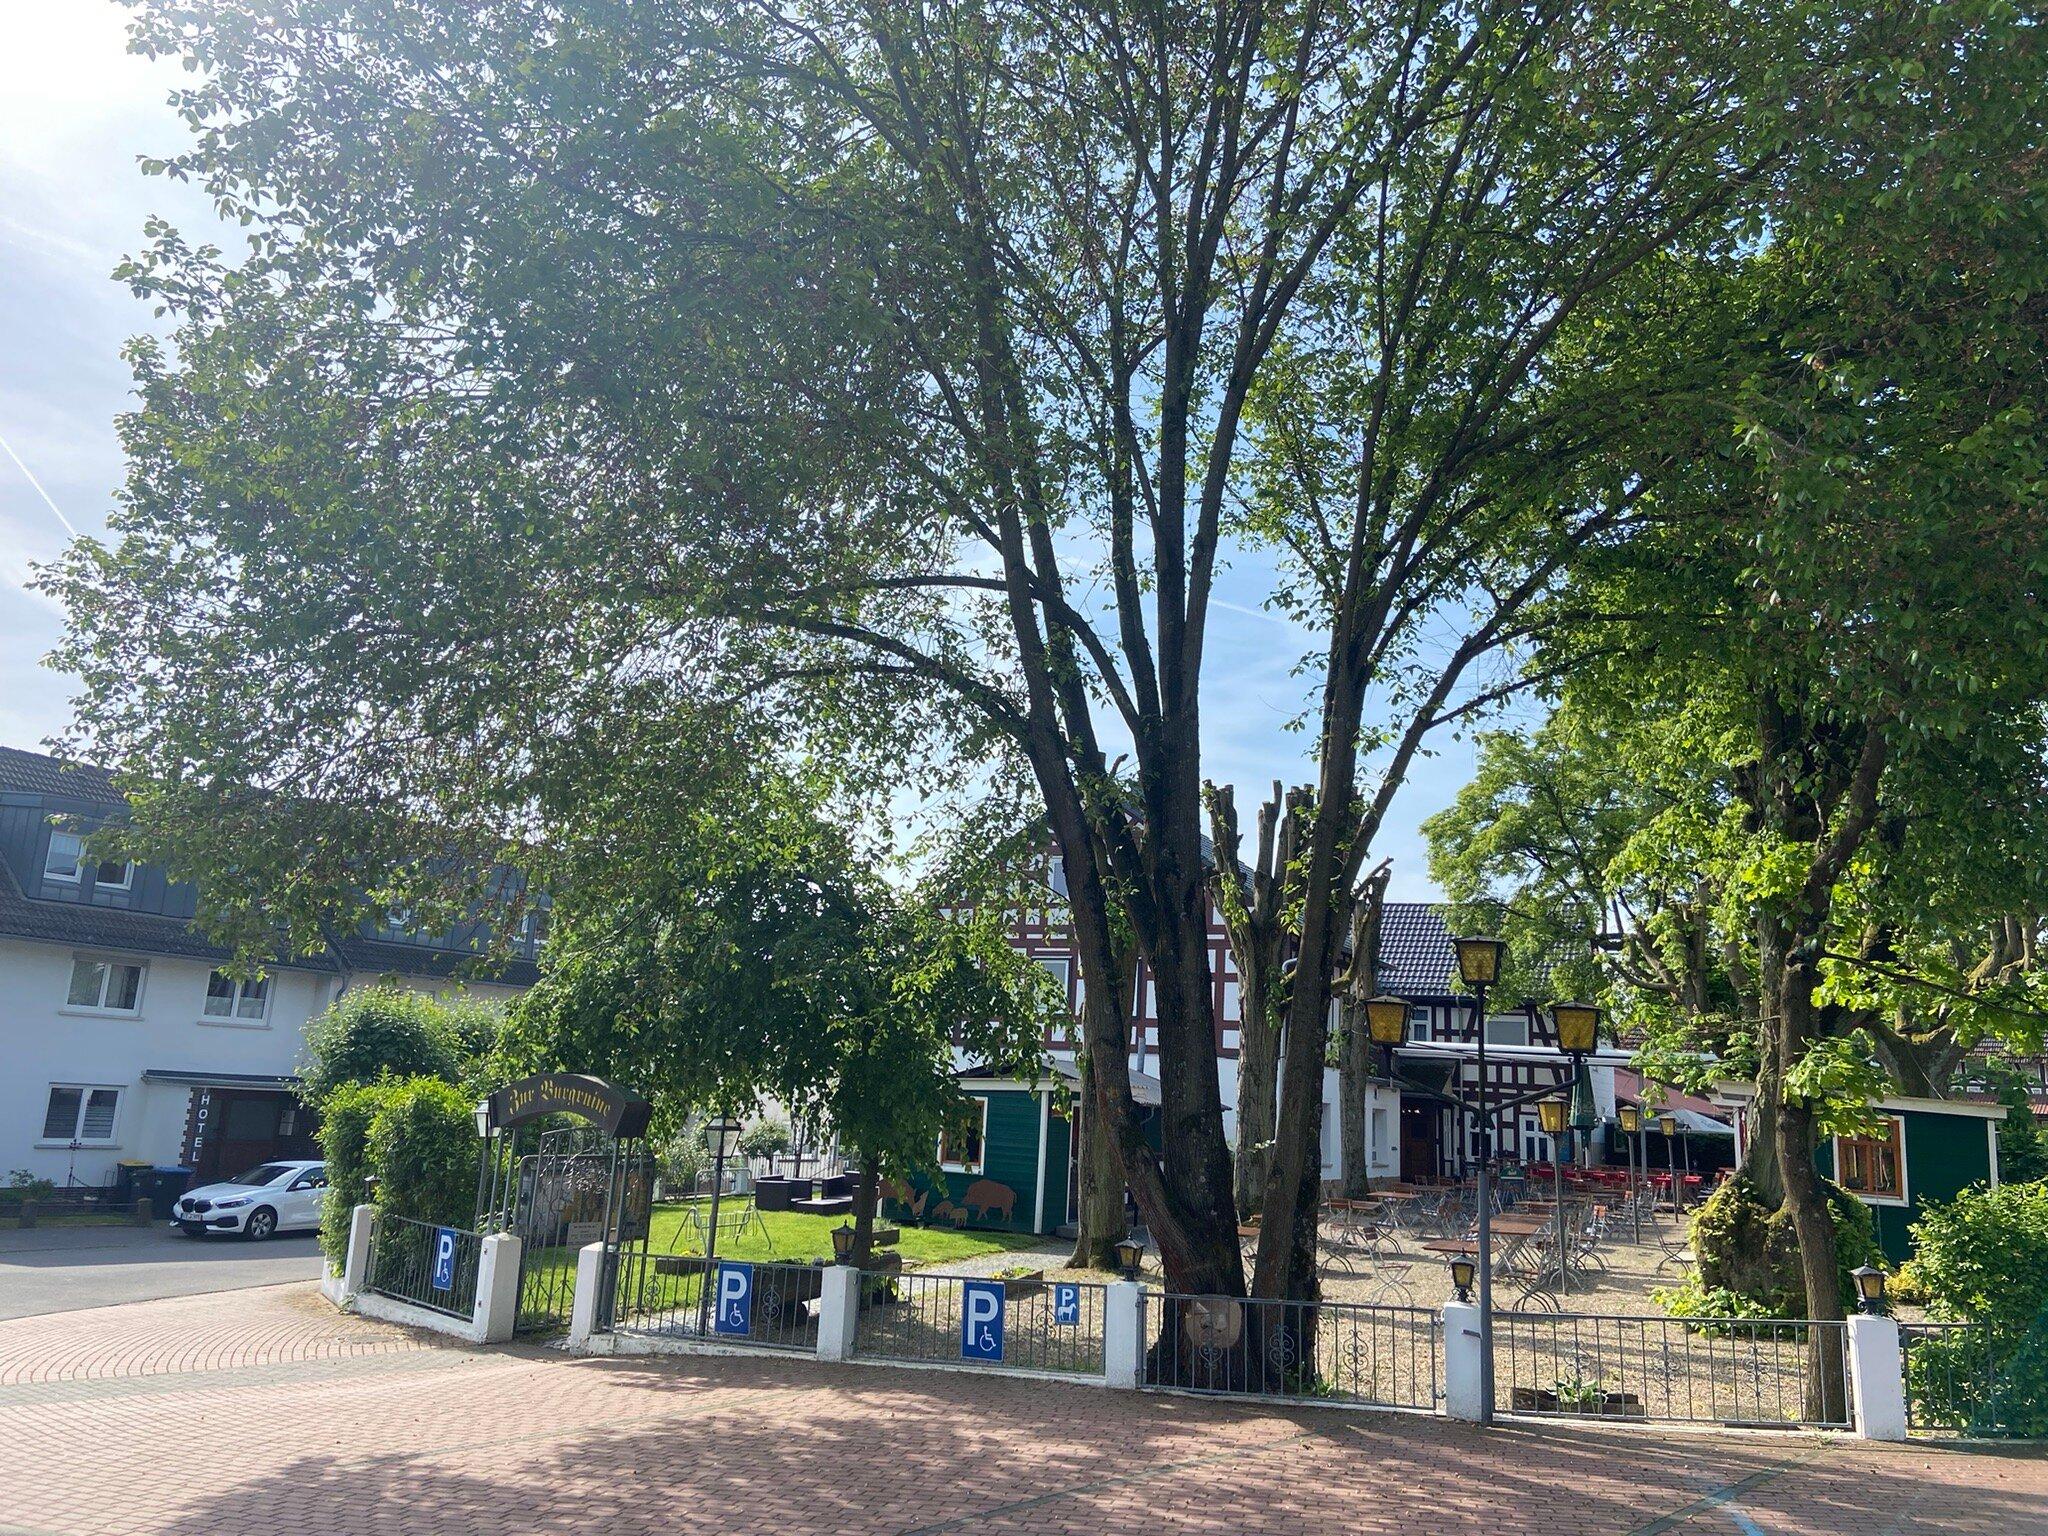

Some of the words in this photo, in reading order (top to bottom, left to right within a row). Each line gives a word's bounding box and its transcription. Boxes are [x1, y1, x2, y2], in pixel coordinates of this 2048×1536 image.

[509, 1089, 534, 1115] Zur
[541, 1080, 611, 1117] Burgruine
[192, 1095, 210, 1162] HOTEL
[436, 1234, 453, 1278] P
[720, 1270, 747, 1322] P
[967, 1290, 999, 1346] P
[1061, 1288, 1074, 1306] P
